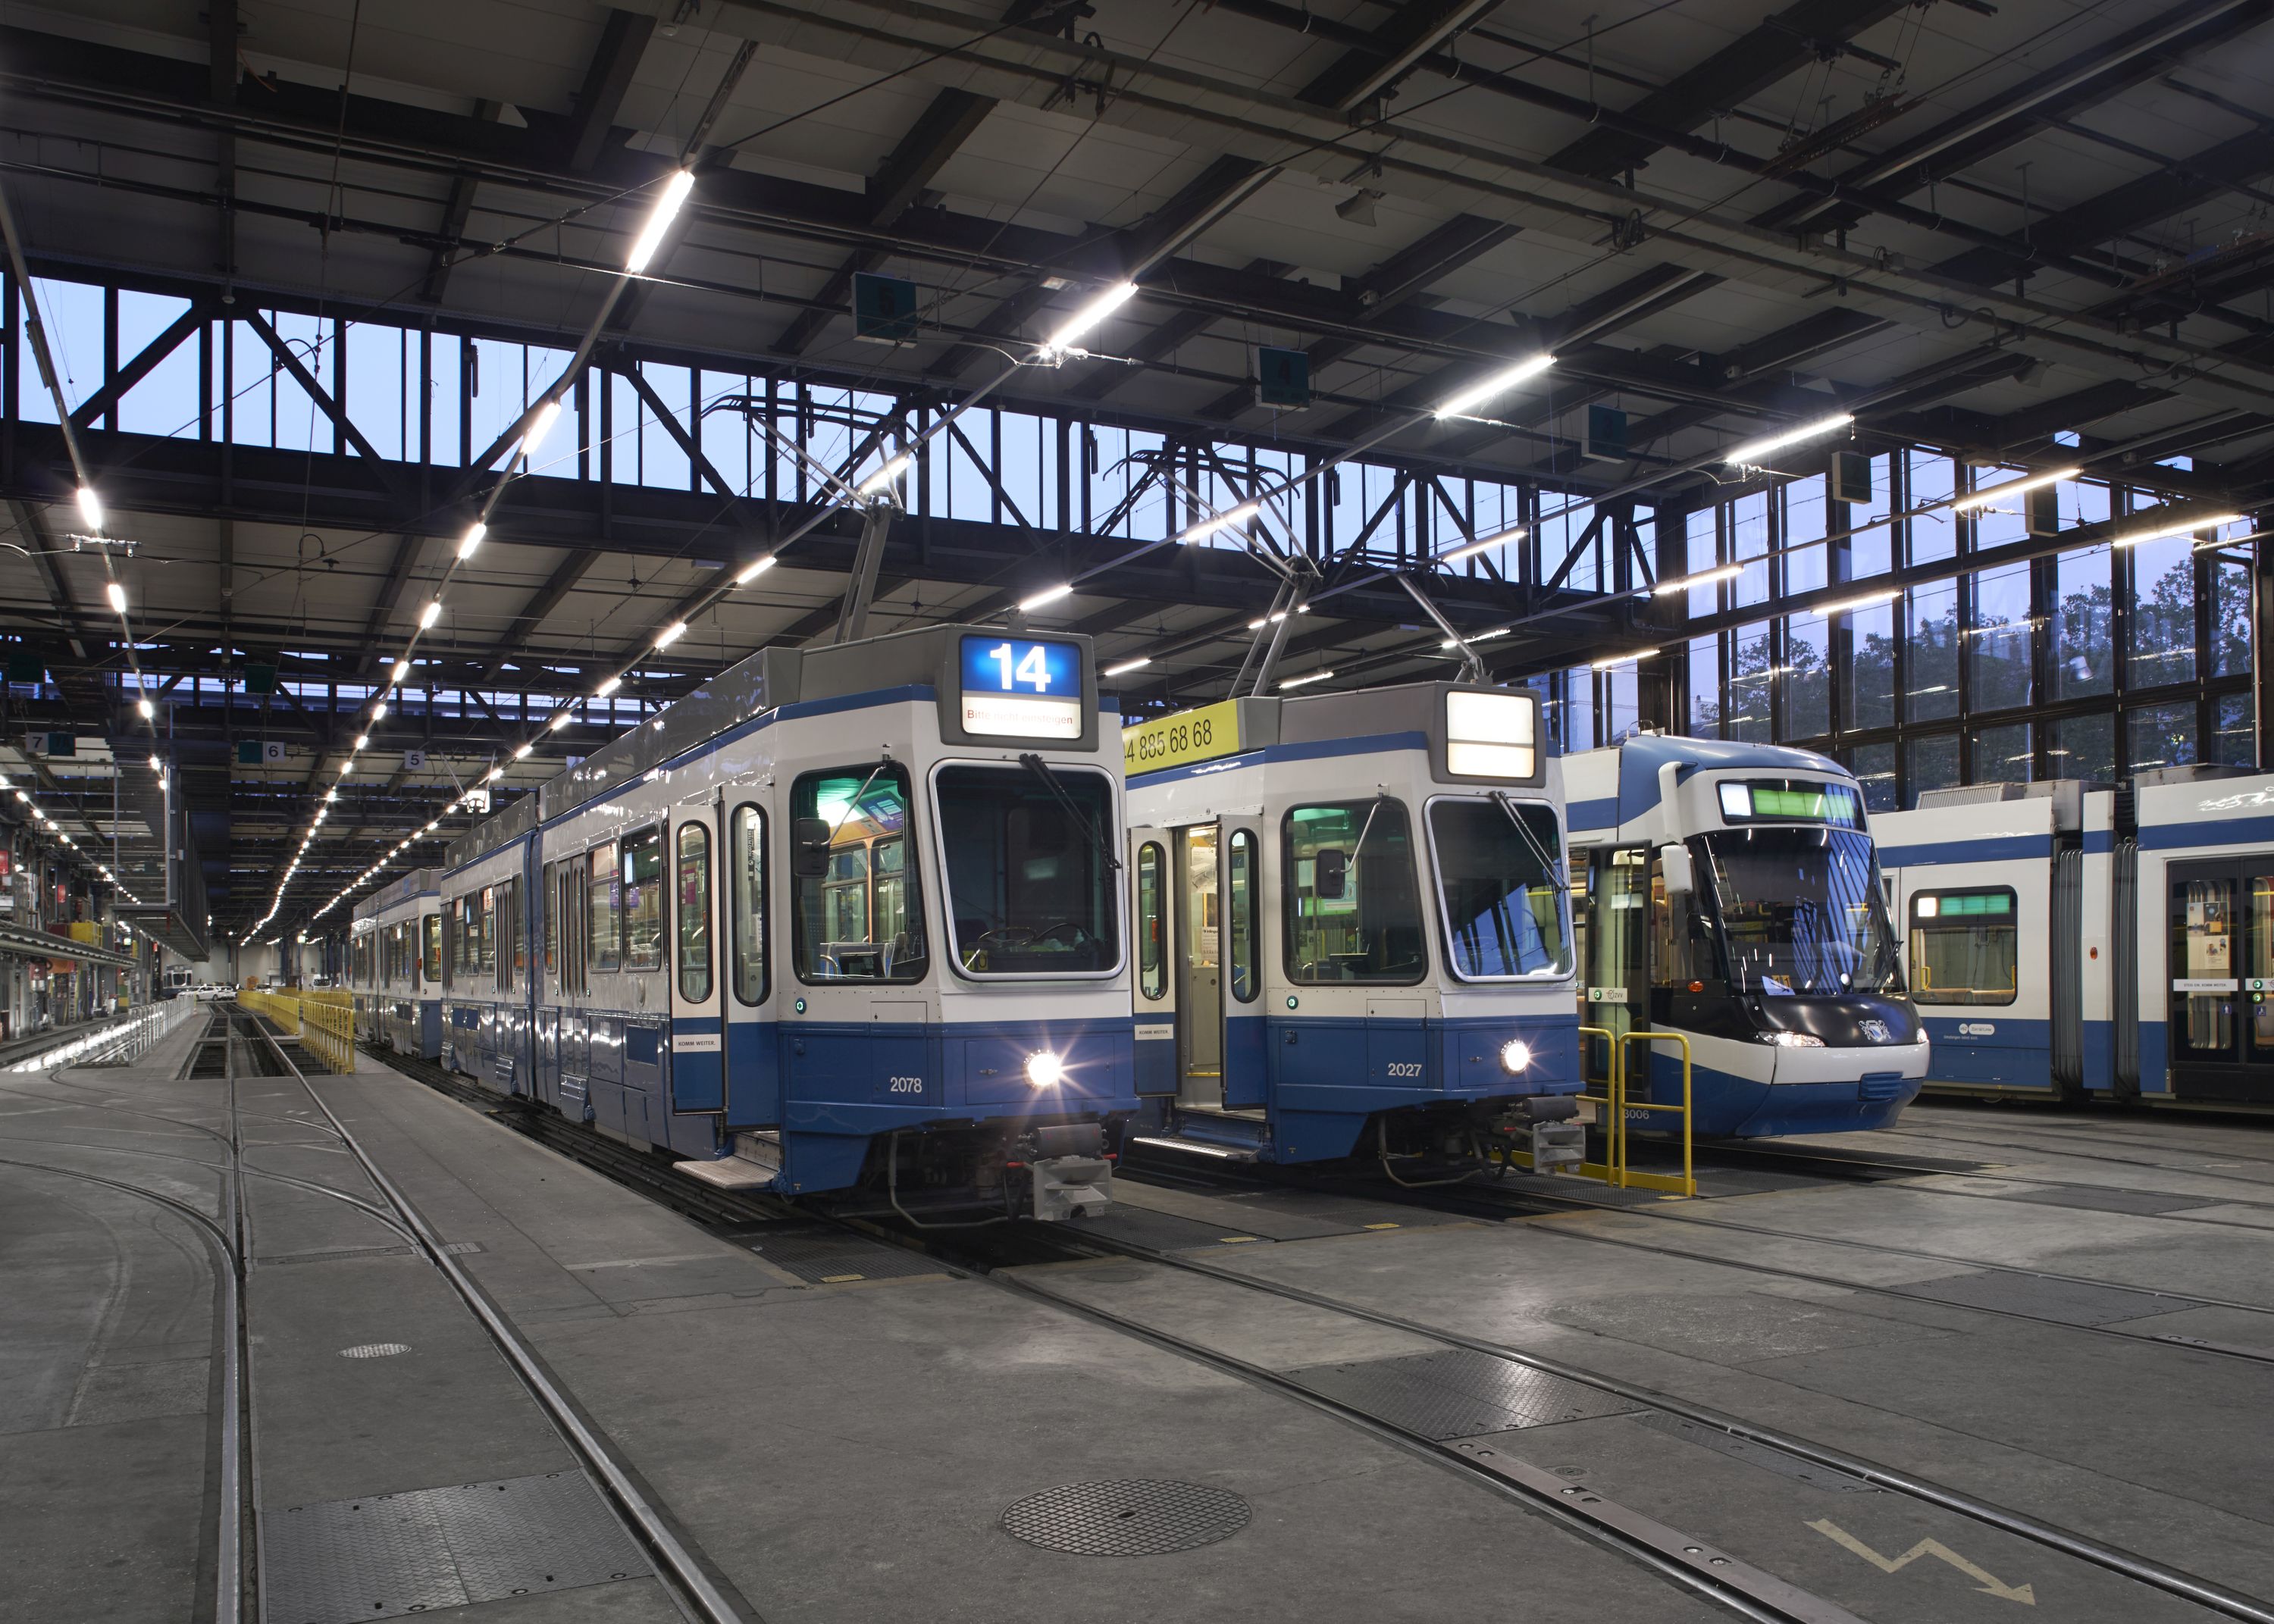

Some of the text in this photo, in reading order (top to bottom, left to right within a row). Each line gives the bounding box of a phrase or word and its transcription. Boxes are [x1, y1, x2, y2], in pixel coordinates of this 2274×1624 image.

[990, 643, 1051, 693] 14
[967, 709, 1073, 725] Bitte nicht einsteigen
[33, 737, 42, 748] 7
[1123, 719, 1212, 763] 4 885 68 68
[268, 746, 279, 757] 6
[411, 755, 419, 765] 5
[1388, 1062, 1422, 1077] 2027
[890, 1076, 922, 1094] 2078
[1624, 1109, 1649, 1119] 3006
